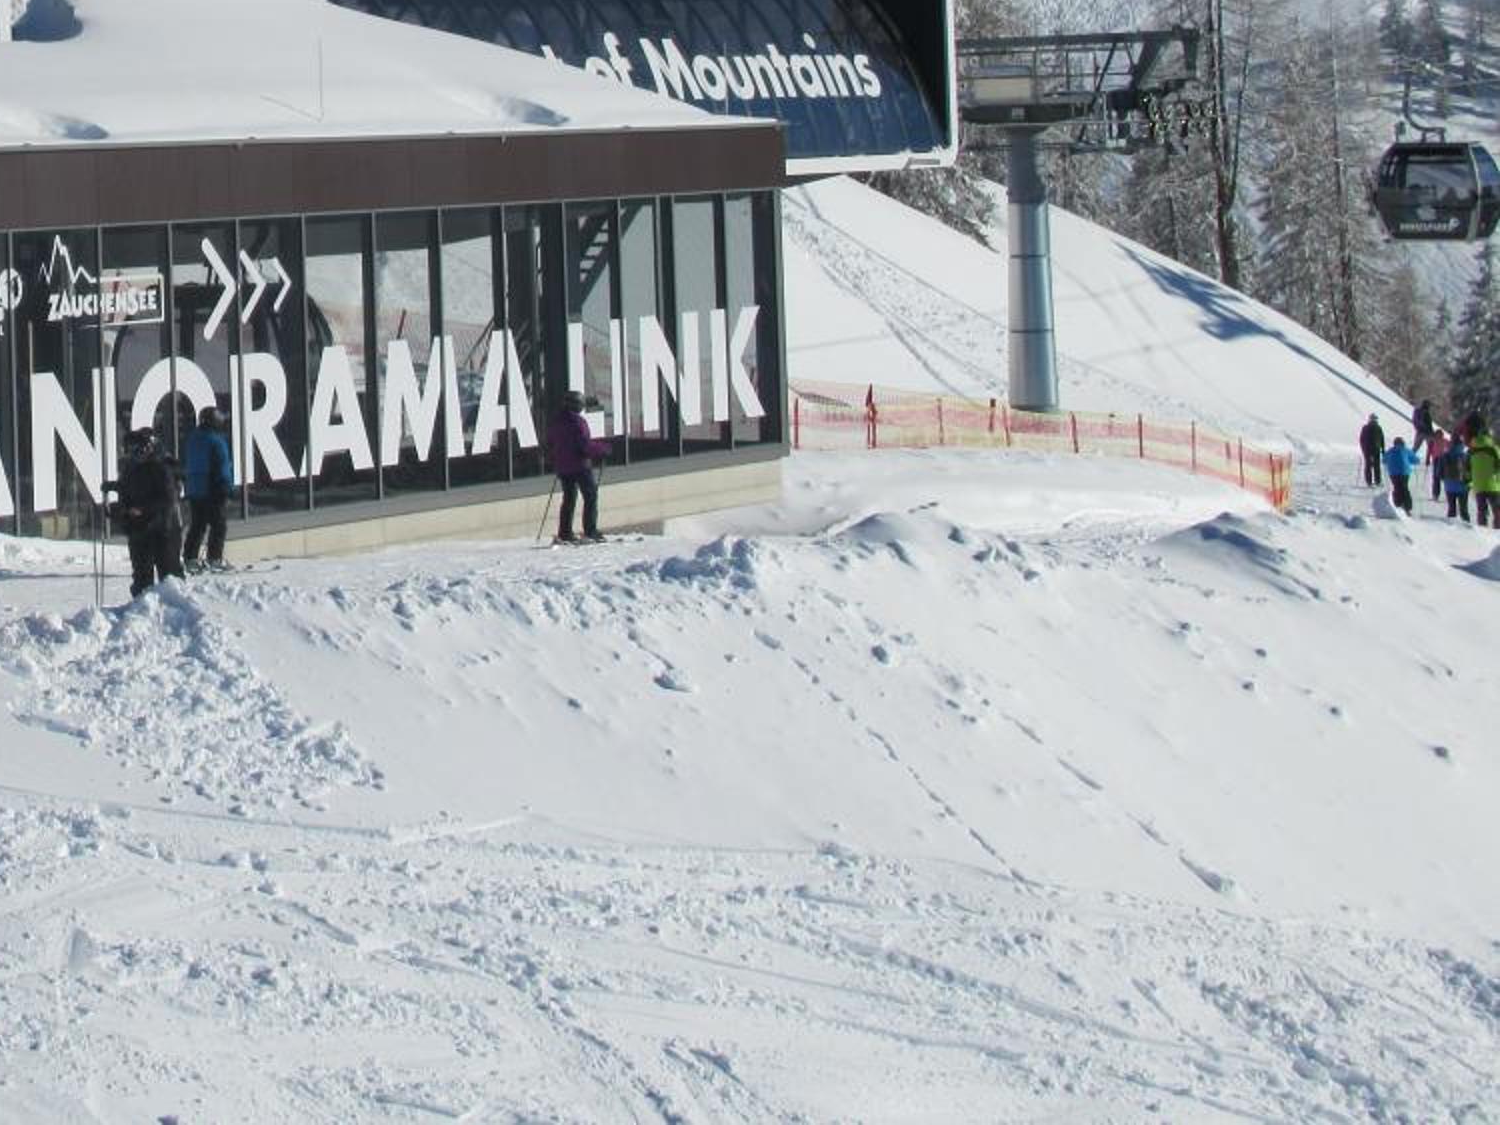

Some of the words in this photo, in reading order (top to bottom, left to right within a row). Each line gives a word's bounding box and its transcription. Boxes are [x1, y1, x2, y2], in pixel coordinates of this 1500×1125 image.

[640, 32, 881, 101] Mountains
[47, 289, 157, 323] ZAUCHENSEE
[569, 306, 766, 438] LINK
